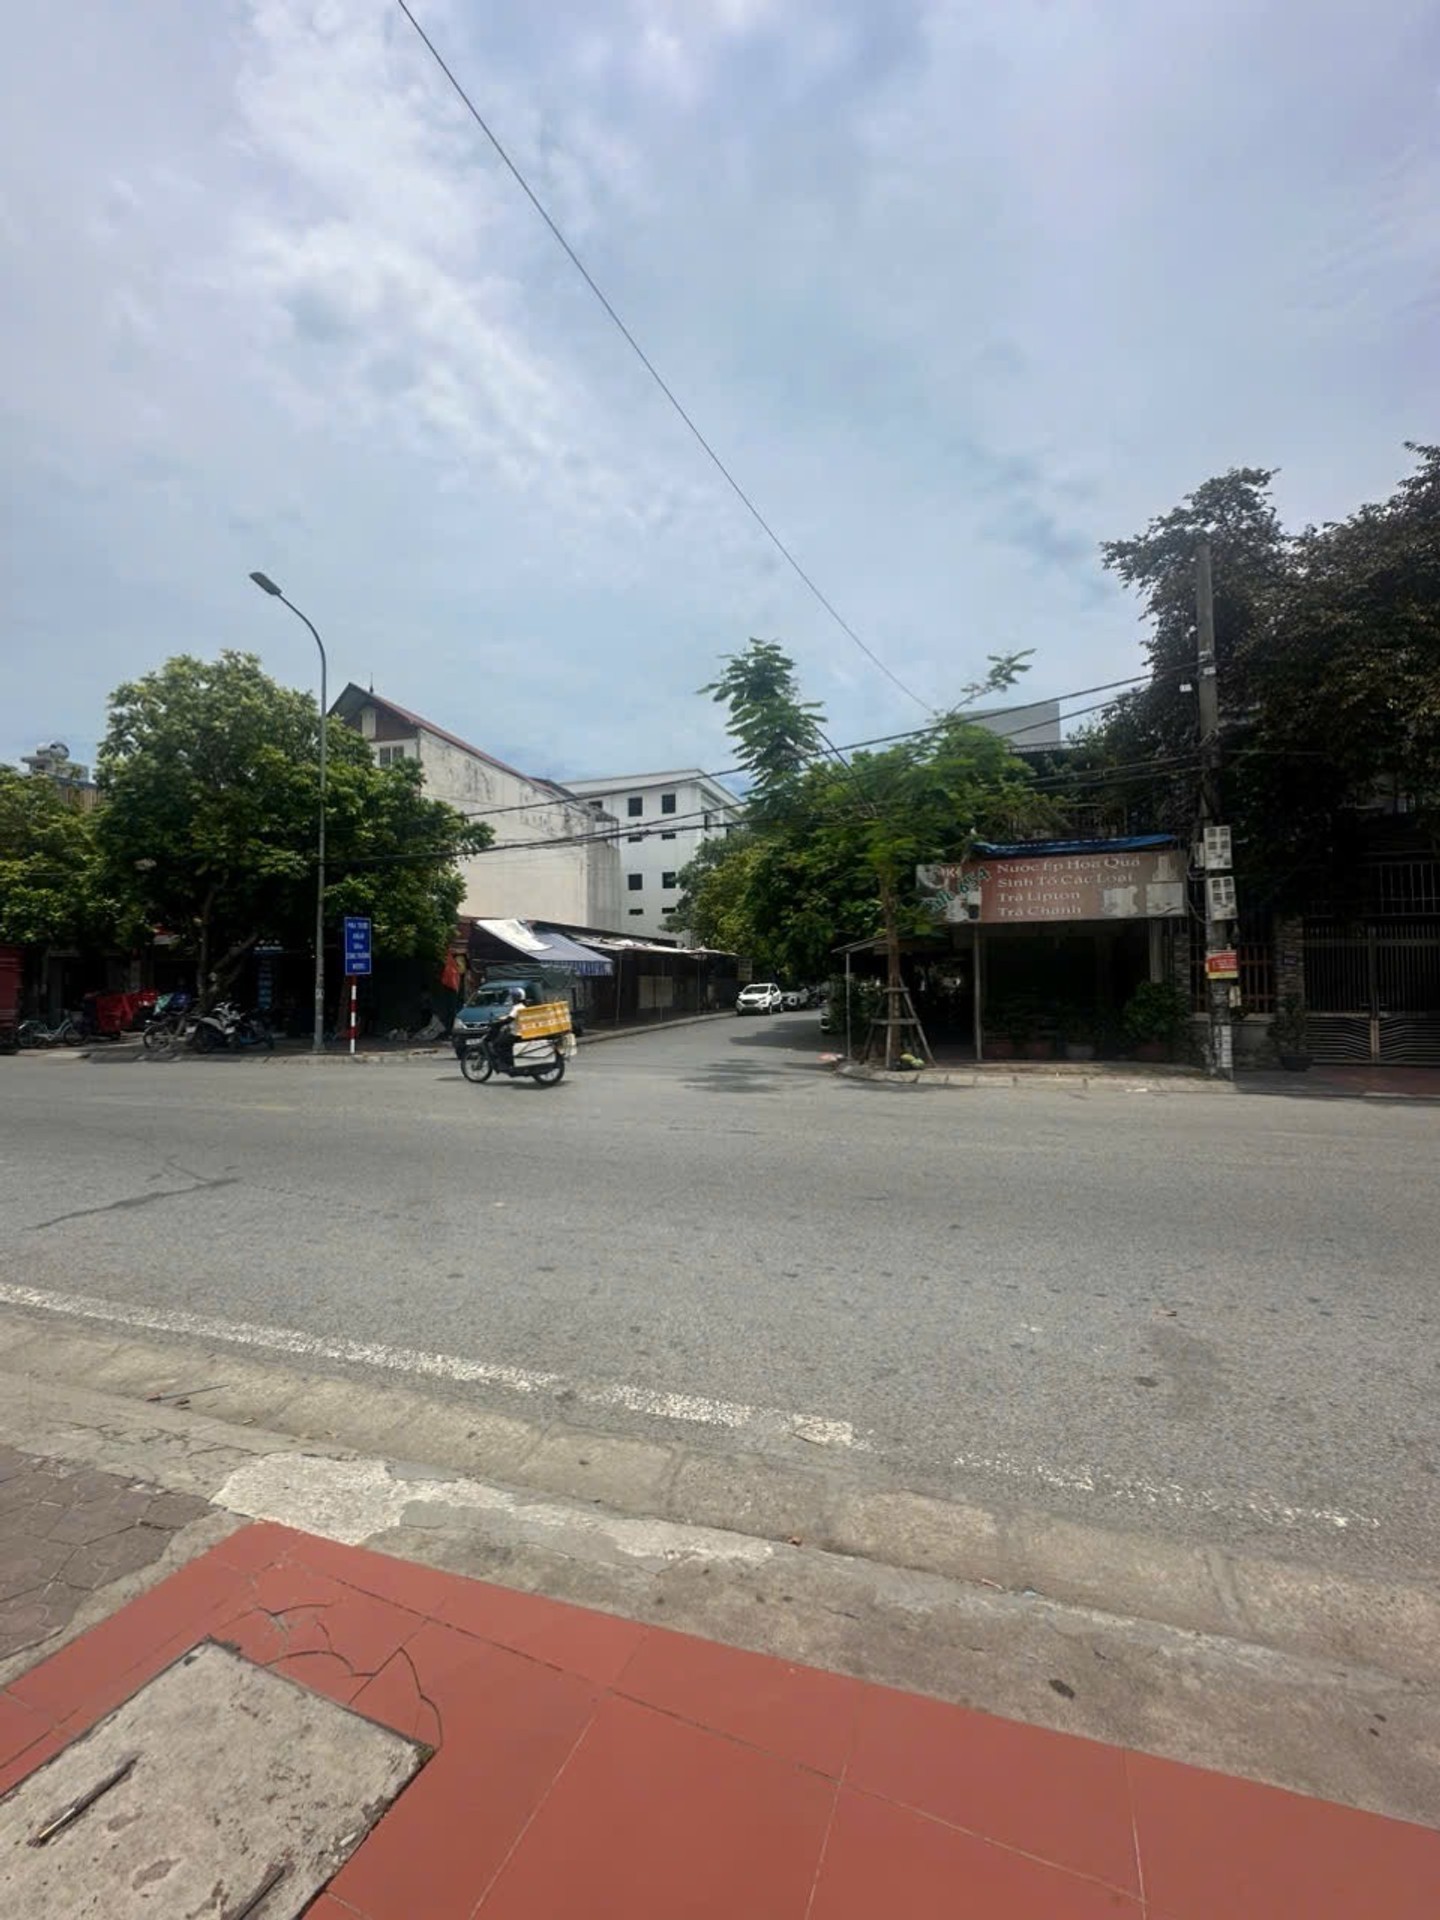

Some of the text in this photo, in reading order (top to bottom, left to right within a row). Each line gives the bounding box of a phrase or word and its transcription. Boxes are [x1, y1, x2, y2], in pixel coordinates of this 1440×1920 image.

[1067, 859, 1101, 870] Hoa
[997, 877, 1034, 888] Sinh
[1027, 891, 1080, 902] Lipton
[1027, 905, 1082, 916] Chanh
